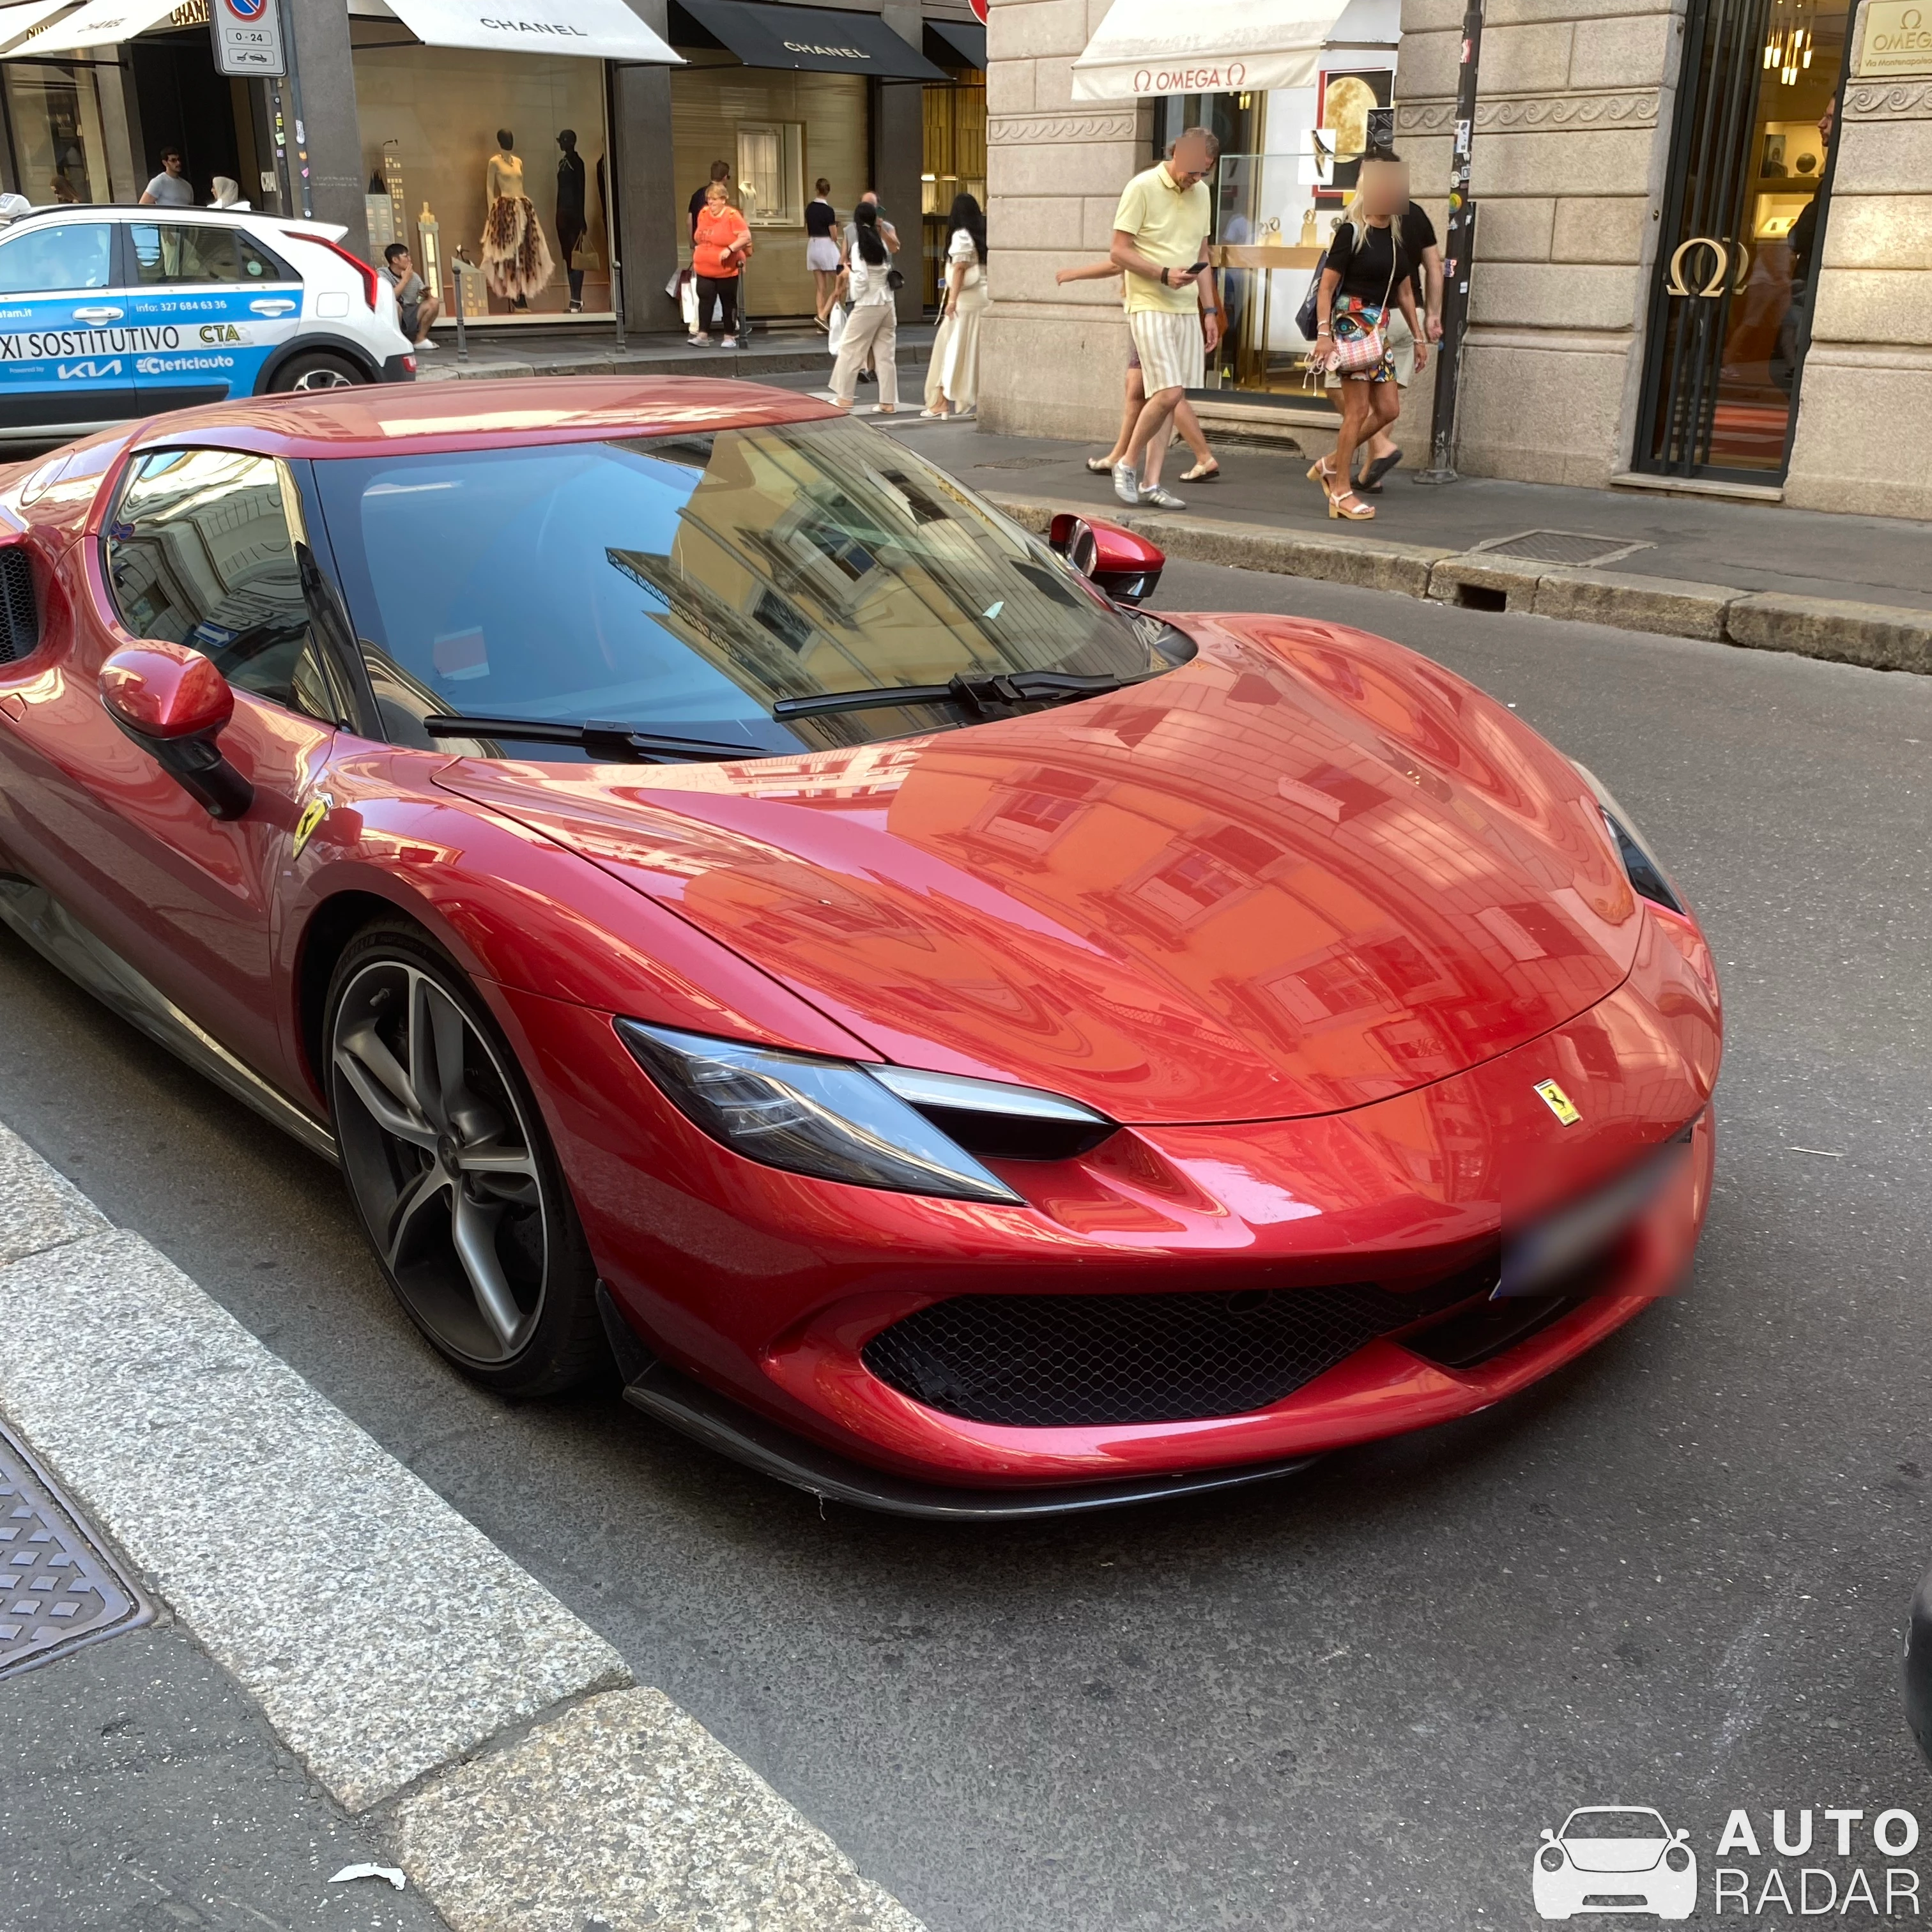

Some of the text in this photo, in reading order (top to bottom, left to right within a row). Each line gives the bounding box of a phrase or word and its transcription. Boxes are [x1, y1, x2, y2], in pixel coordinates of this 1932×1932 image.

[480, 18, 588, 36] CHANEL
[1873, 31, 1932, 50] OMEG
[783, 42, 871, 58] CHANEL
[1156, 69, 1220, 90] OMEGA
[136, 301, 227, 312] info: 327 684 63 36
[29, 326, 179, 358] SOSTITUTIVO
[199, 325, 241, 343] CTA
[142, 356, 234, 374] Clericiauto
